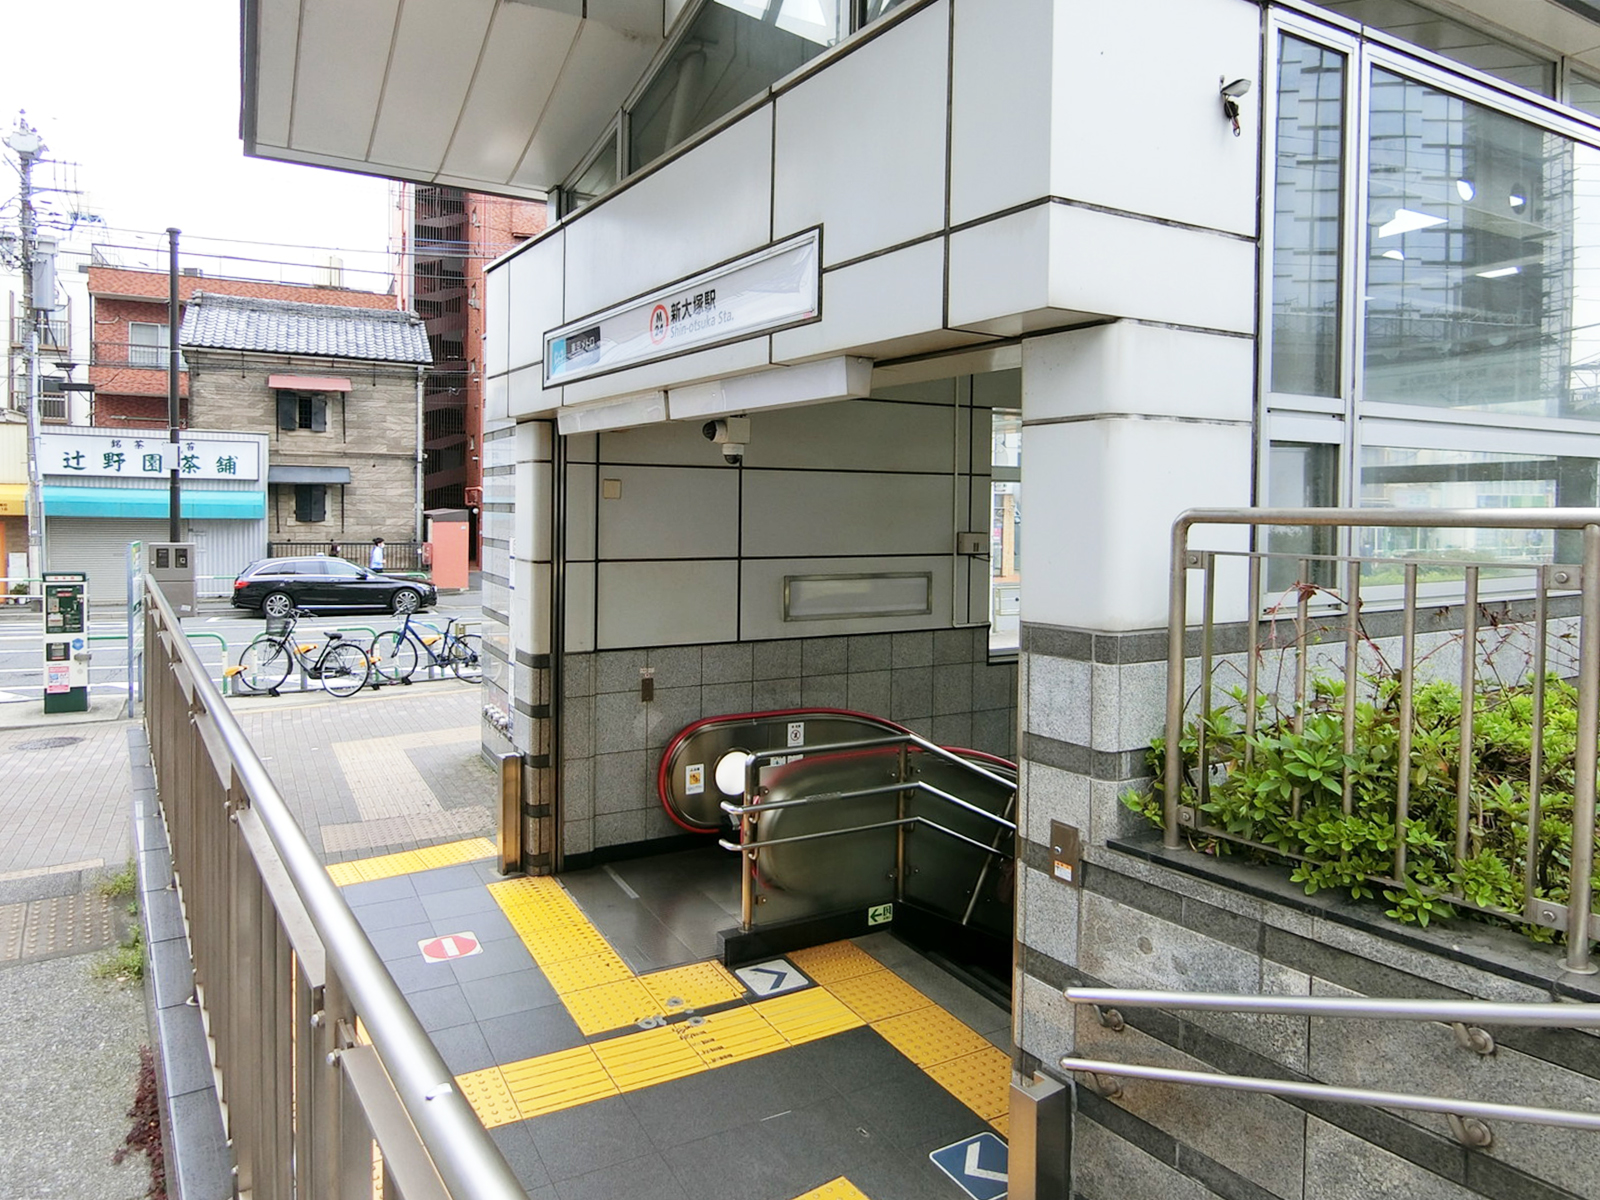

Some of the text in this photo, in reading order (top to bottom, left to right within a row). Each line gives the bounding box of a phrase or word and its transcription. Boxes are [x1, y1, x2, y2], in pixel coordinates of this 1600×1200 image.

[655, 311, 663, 324] M
[670, 289, 716, 325] 新大塚駅
[654, 324, 664, 337] 24
[670, 310, 734, 339] Shin-otsuka Sta.
